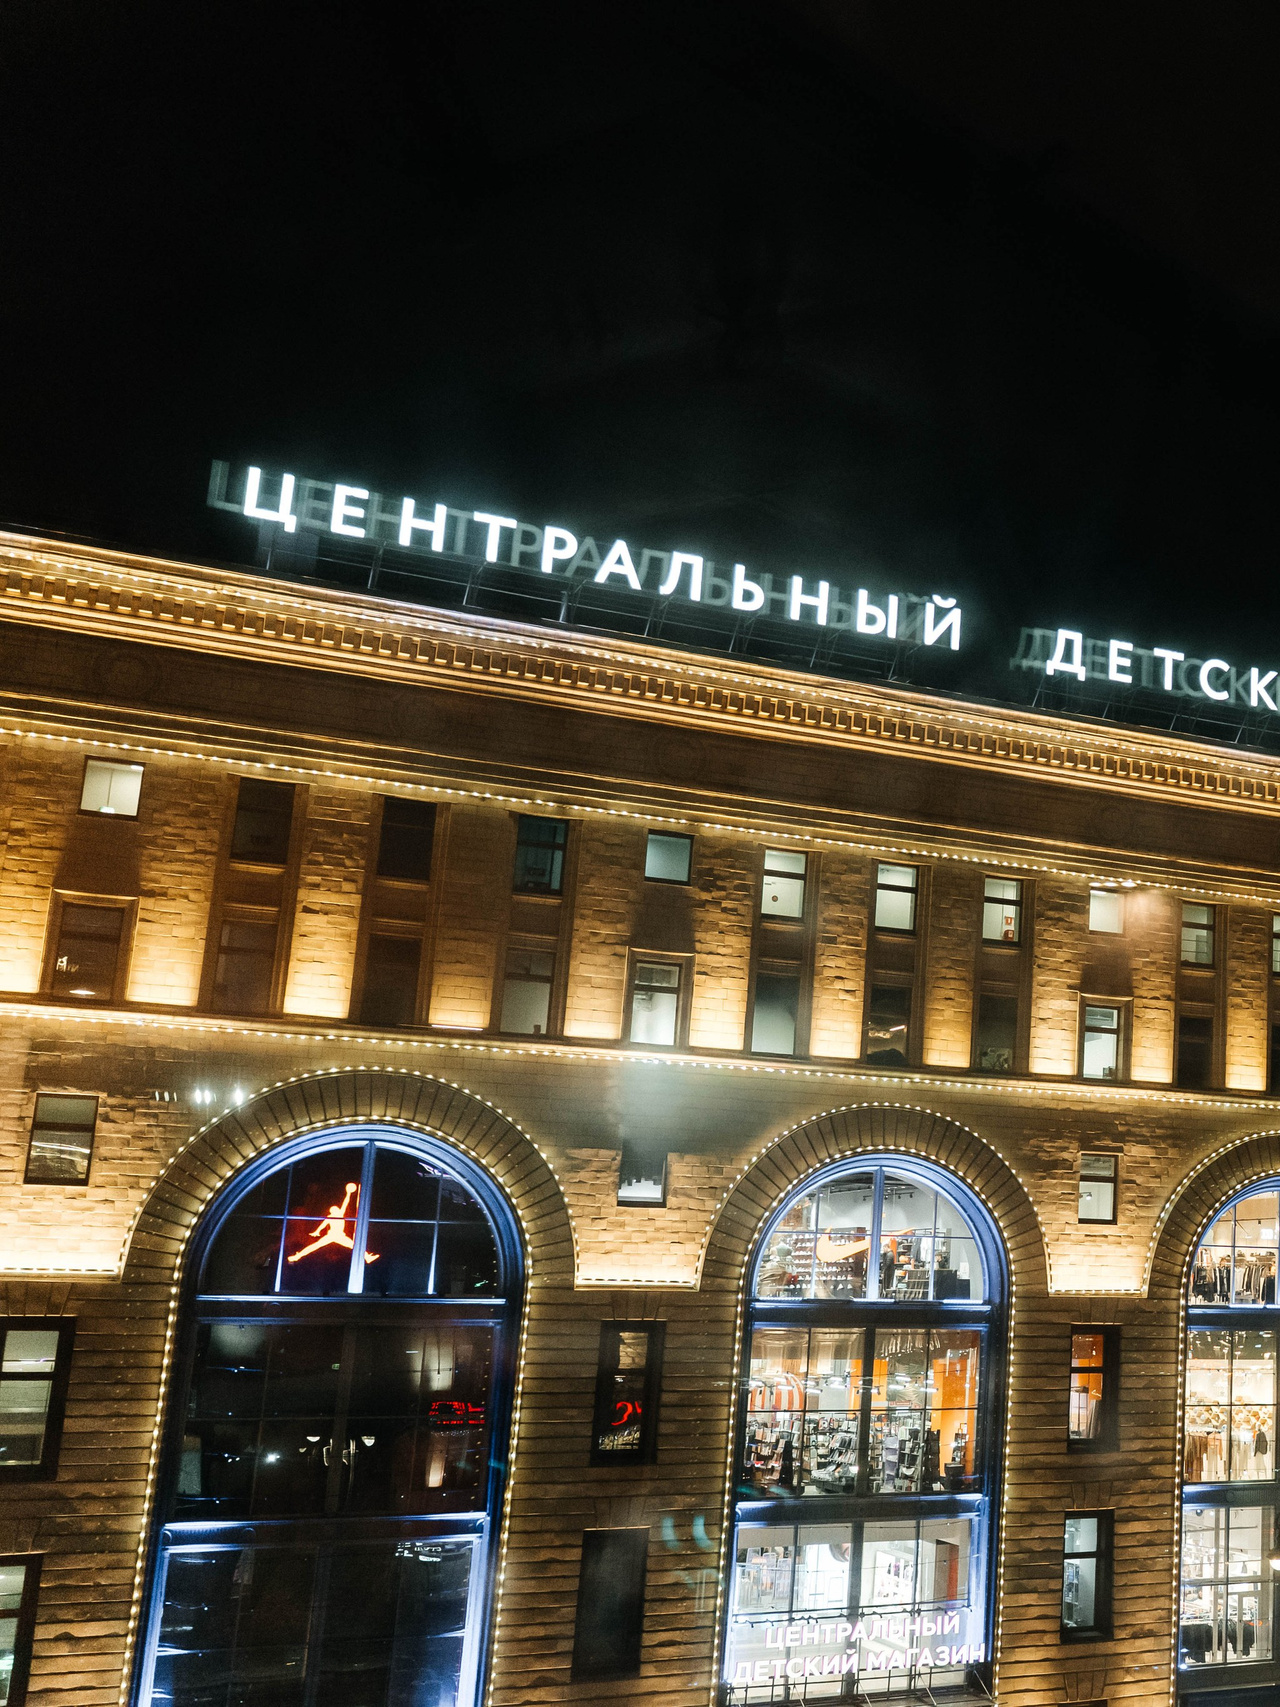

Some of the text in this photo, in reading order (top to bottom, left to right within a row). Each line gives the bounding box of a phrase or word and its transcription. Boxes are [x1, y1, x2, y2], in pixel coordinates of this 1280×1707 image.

[243, 466, 963, 650] ЦЕНТРАЛЬНЫЙ
[765, 1612, 960, 1650] ЦЕНТРАЛЬНЫЙ
[733, 1643, 985, 1684] ДЕТСКИЙ МАГАЗИН
